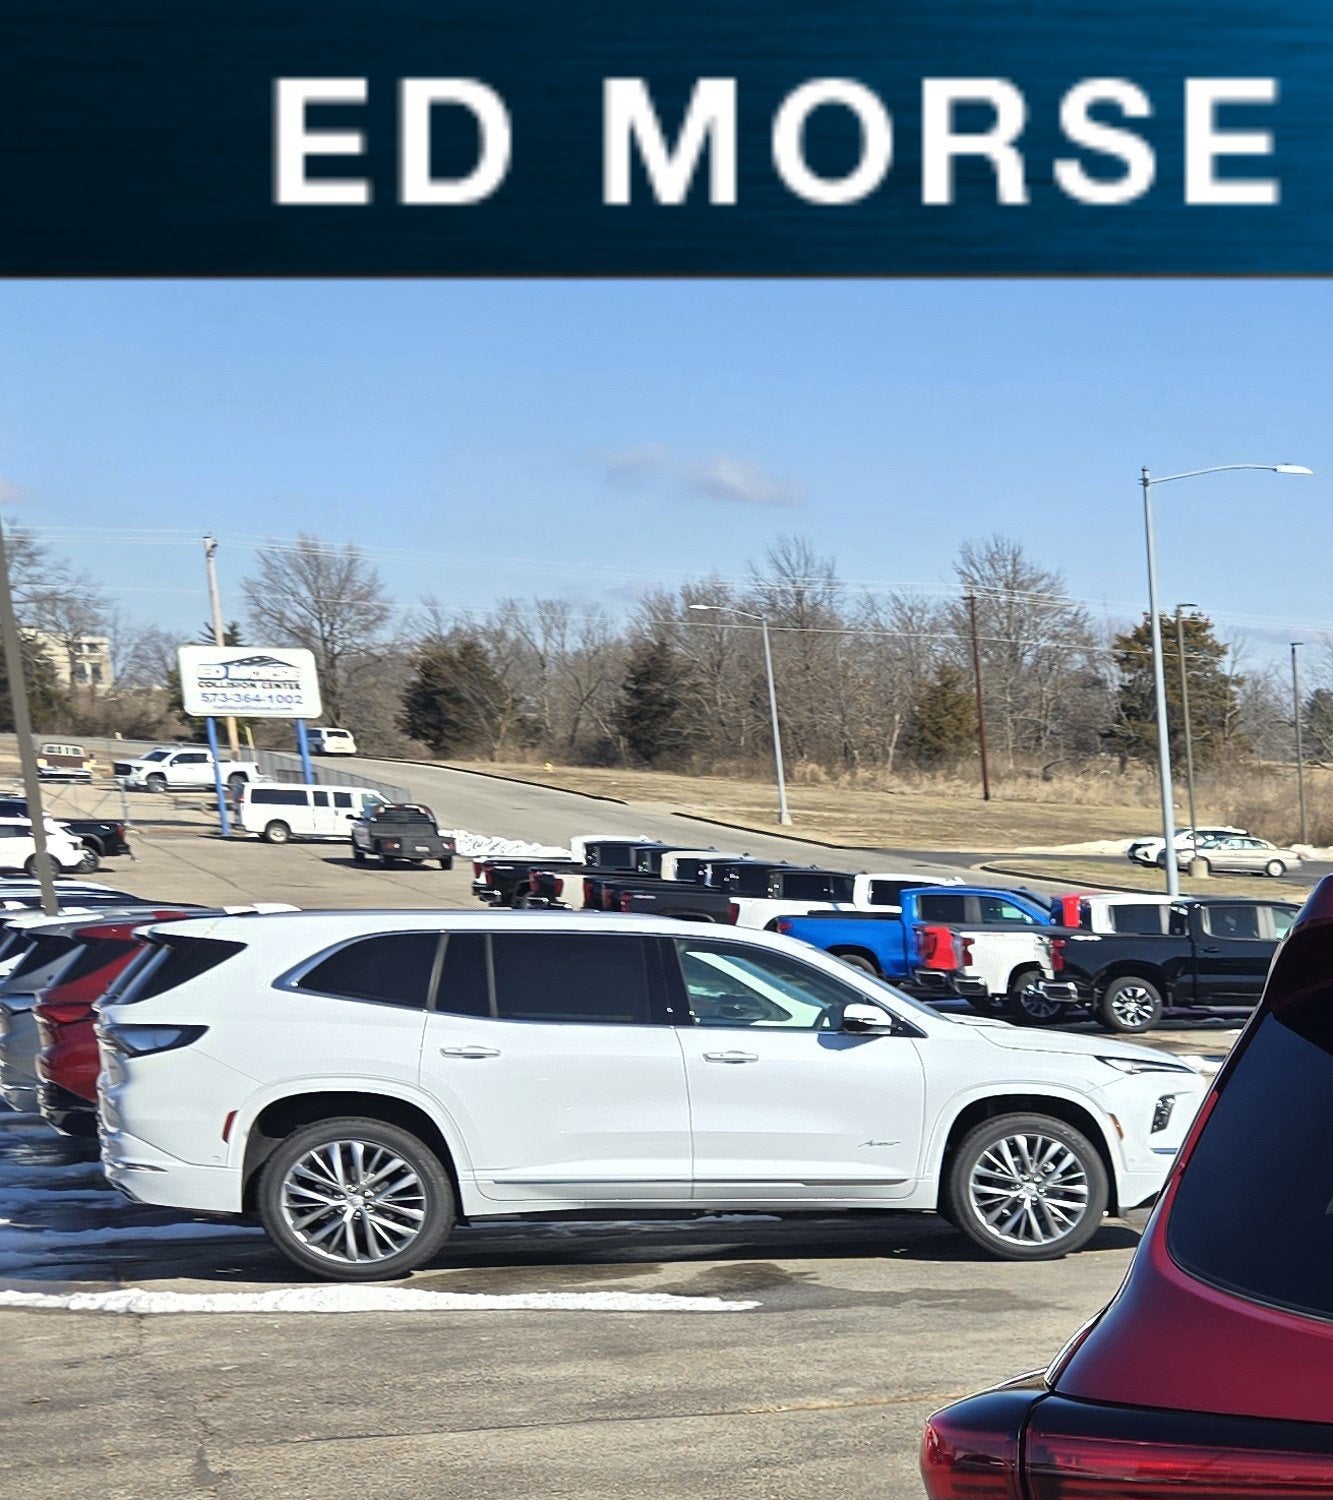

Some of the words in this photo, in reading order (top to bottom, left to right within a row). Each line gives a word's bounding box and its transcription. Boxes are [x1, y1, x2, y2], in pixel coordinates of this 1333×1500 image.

[198, 681, 257, 690] COLLISION
[262, 682, 301, 691] CENTER
[201, 693, 303, 705] 573-364-1002
